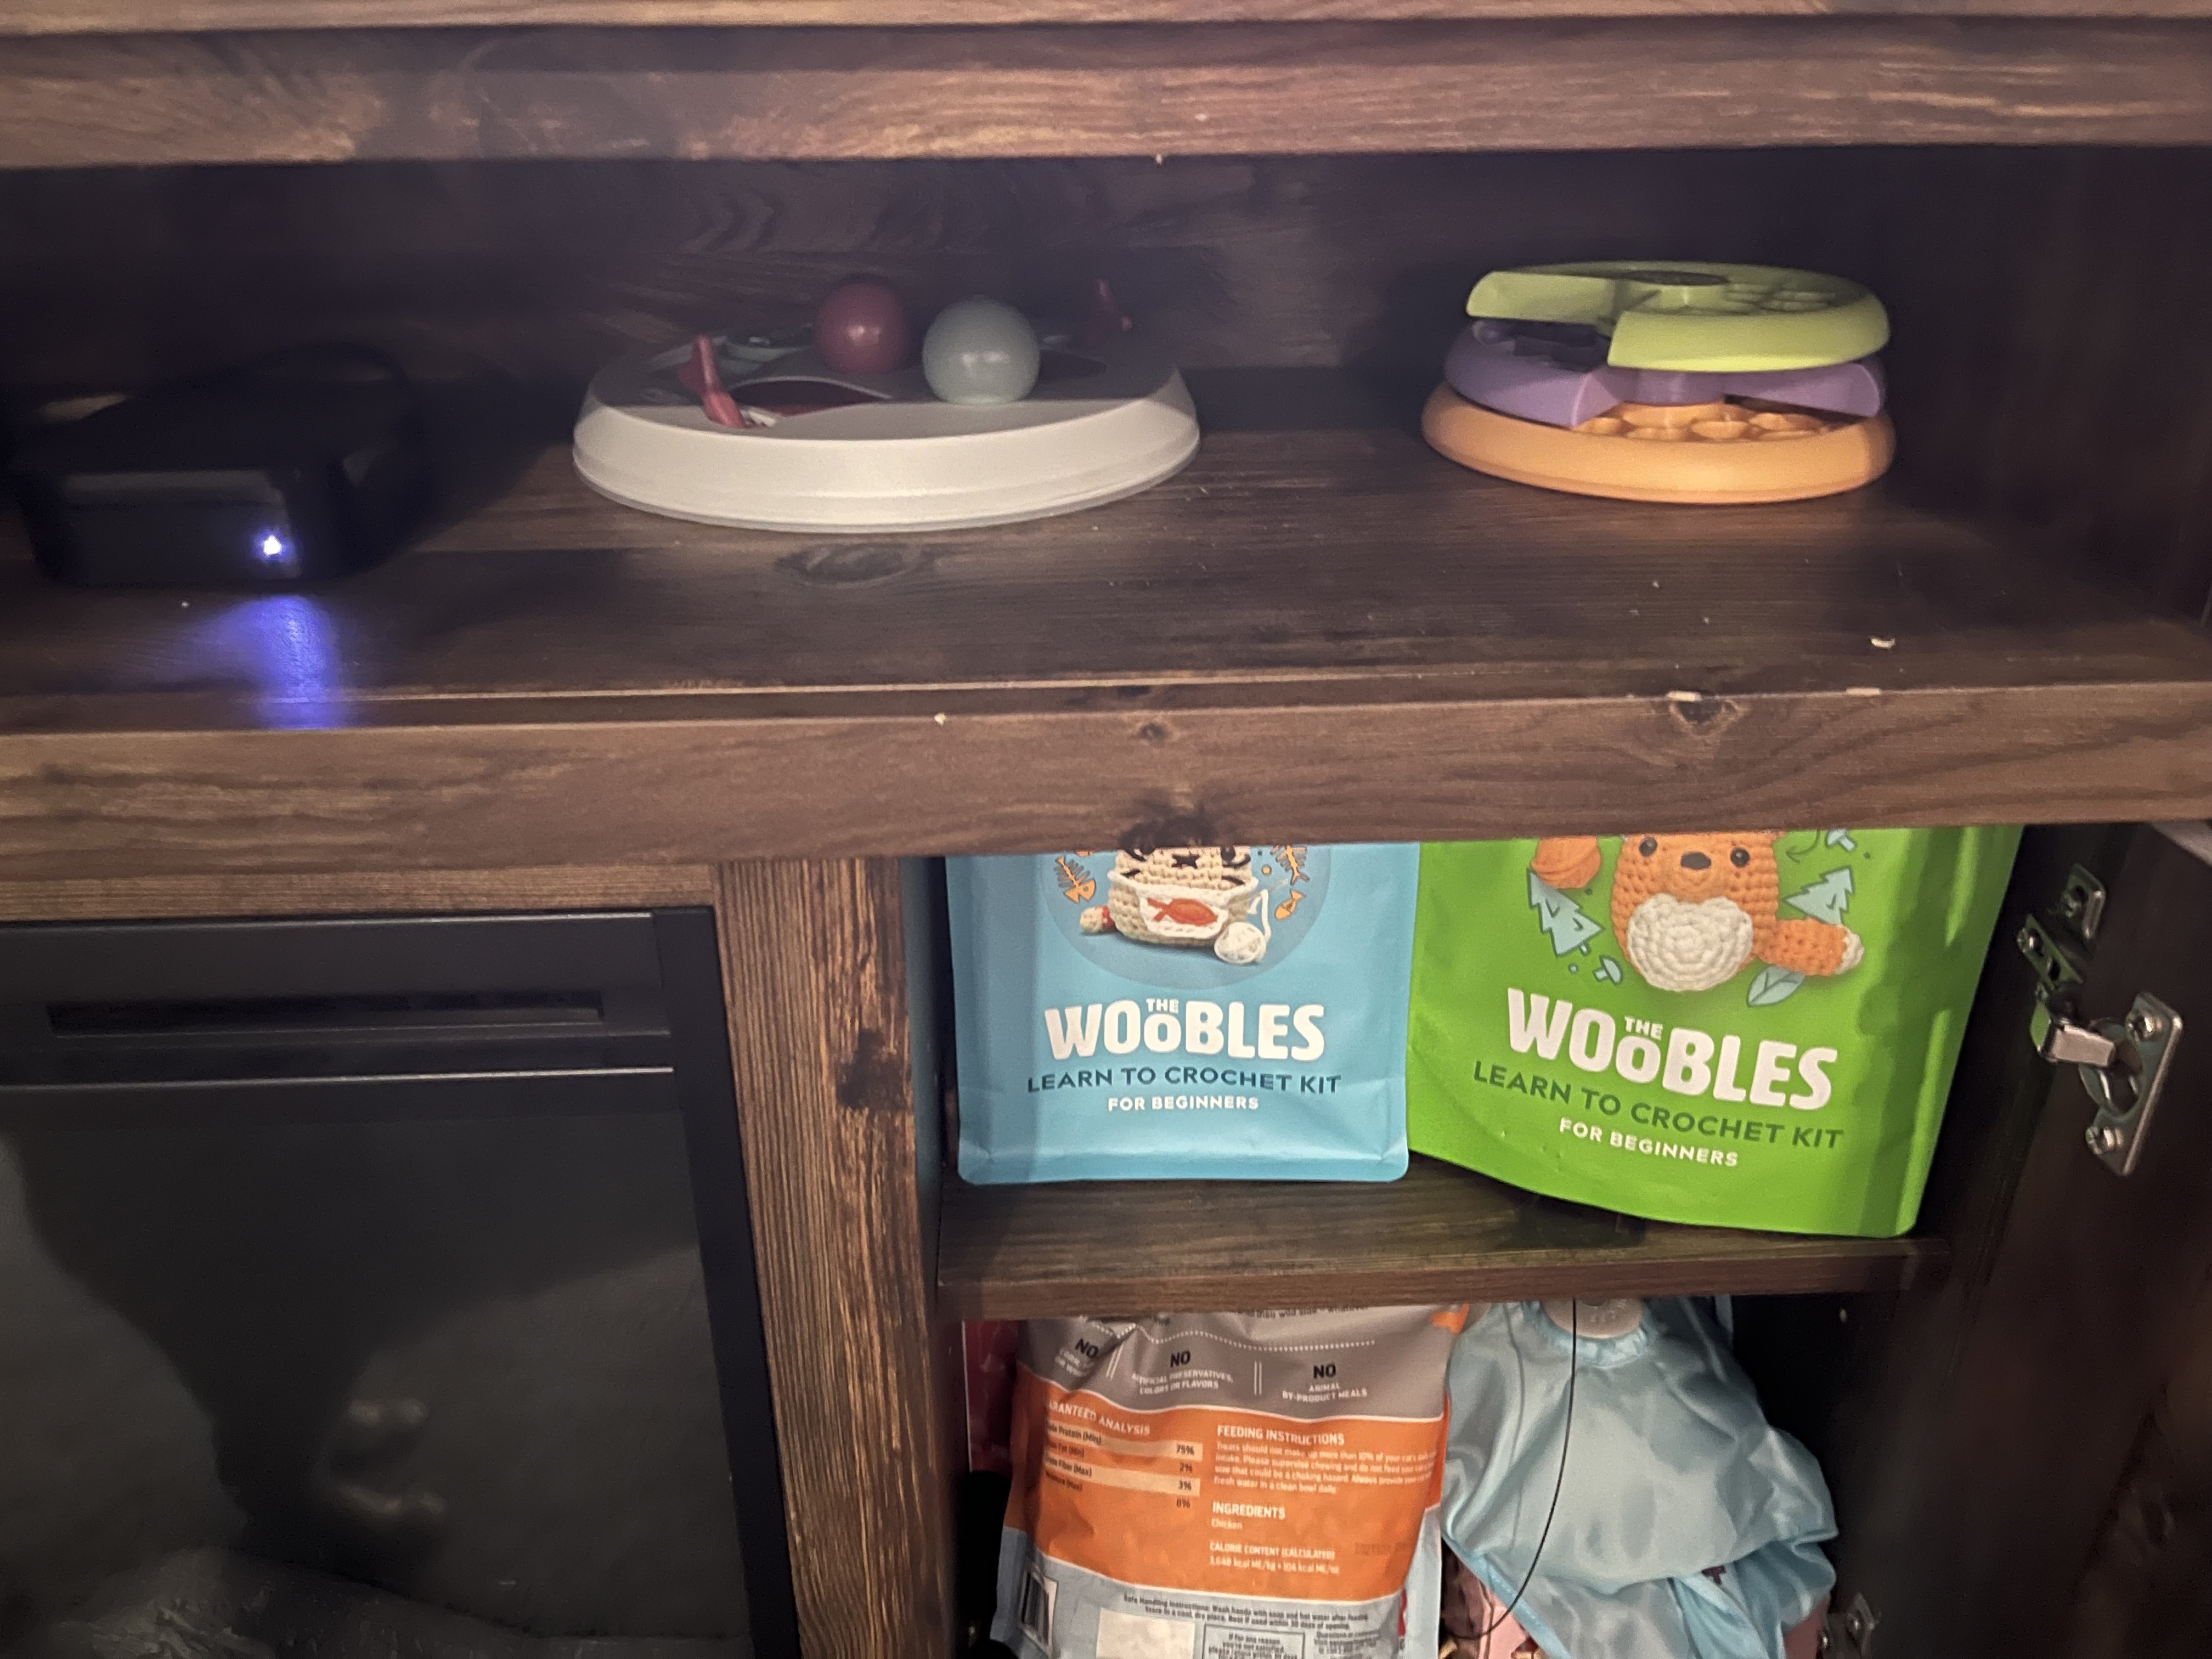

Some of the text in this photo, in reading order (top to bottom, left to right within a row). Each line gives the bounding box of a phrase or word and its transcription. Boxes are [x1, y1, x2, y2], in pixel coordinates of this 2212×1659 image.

[1146, 998, 1179, 1013] THE
[1044, 1000, 1325, 1061] WOOBLES
[1624, 1016, 1663, 1040] THE
[1508, 988, 1838, 1110] WOOBLES
[1028, 1066, 1341, 1094] LEARN TO CROCHET KIT
[1108, 1096, 1259, 1112] FOR BEGINNERS
[1474, 1060, 1844, 1149] LEARN TO CROCHET KIT
[1560, 1117, 1738, 1167] FOR BEGINNERS
[1075, 1338, 1098, 1358] NO
[1170, 1351, 1190, 1368] NO
[1313, 1363, 1336, 1379] NO
[1139, 1380, 1219, 1396] COLORS OR FLAVORS
[1283, 1387, 1367, 1403] BY-PRODUCT MEALS
[1308, 1381, 1340, 1392] ANIMAL
[1048, 1401, 1150, 1436] ARANTEED ANALYSIS
[1058, 1425, 1081, 1440] Protein
[1176, 1443, 1194, 1455] 75%
[1217, 1425, 1345, 1446] FEEDING INSTRUCTIONS
[1243, 1455, 1270, 1465] Please
[1212, 1500, 1286, 1520] INGREDIENTS
[1211, 1518, 1243, 1530] Chicken
[1210, 1541, 1335, 1561] CALORIE CONTENT (CALCULATED)
